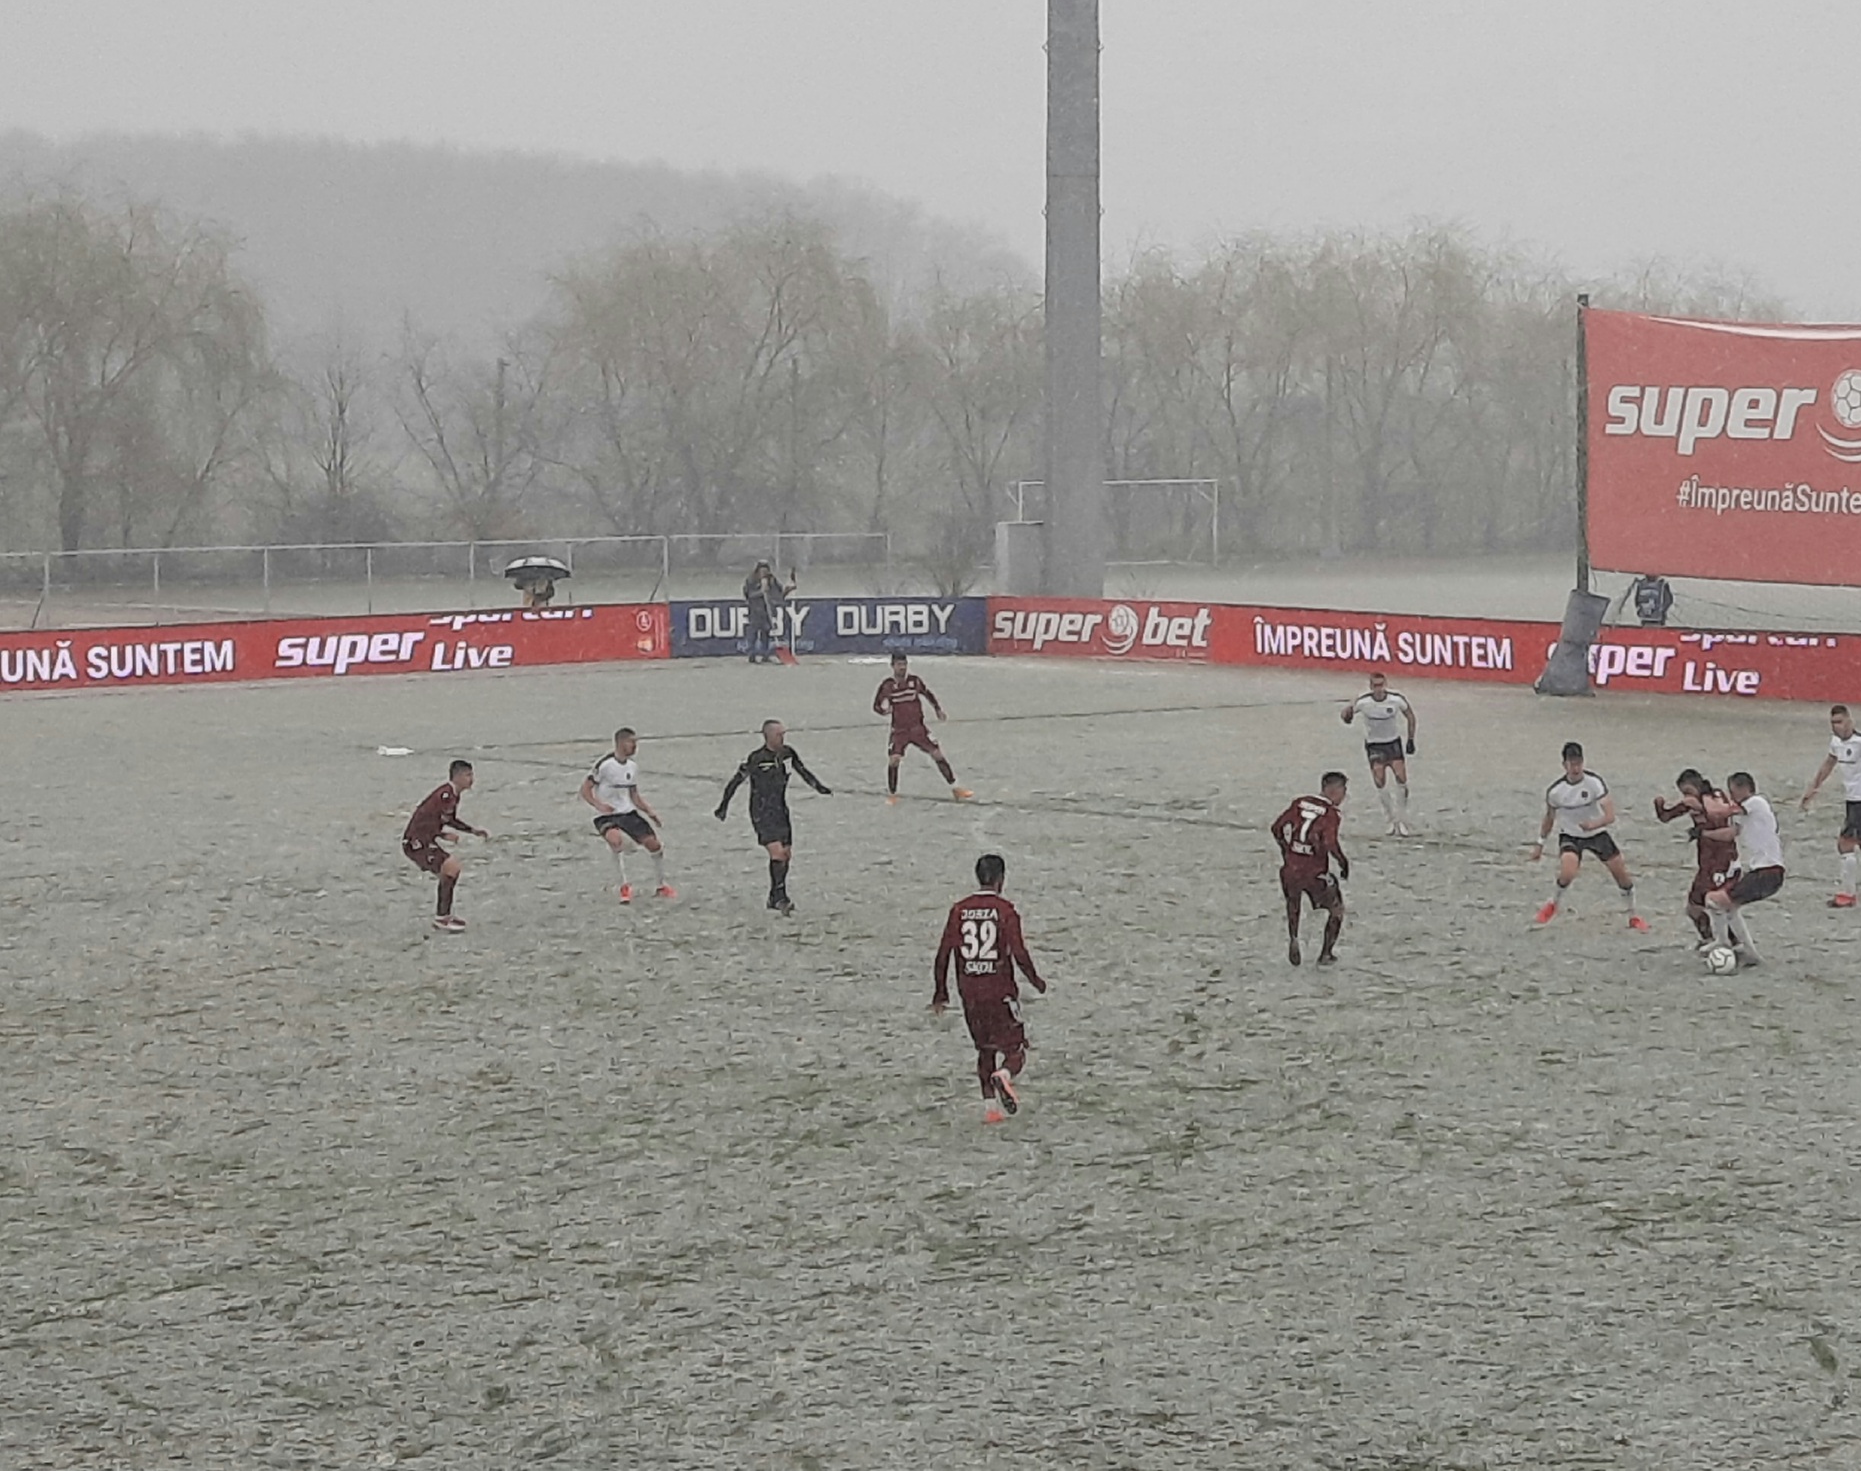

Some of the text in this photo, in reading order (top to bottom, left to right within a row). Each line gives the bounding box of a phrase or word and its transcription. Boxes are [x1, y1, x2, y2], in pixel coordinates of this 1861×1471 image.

[1605, 385, 1817, 455] super
[837, 604, 955, 636] DURBY
[992, 606, 1211, 650] super bet
[87, 640, 233, 680] SUNTEM
[275, 631, 425, 674] super
[431, 641, 513, 671] Live
[1253, 616, 1513, 670] ÎMPREUNĂ SUNTEM
[1683, 661, 1760, 695] Live
[1300, 810, 1319, 843] 7
[960, 920, 998, 960] 32
